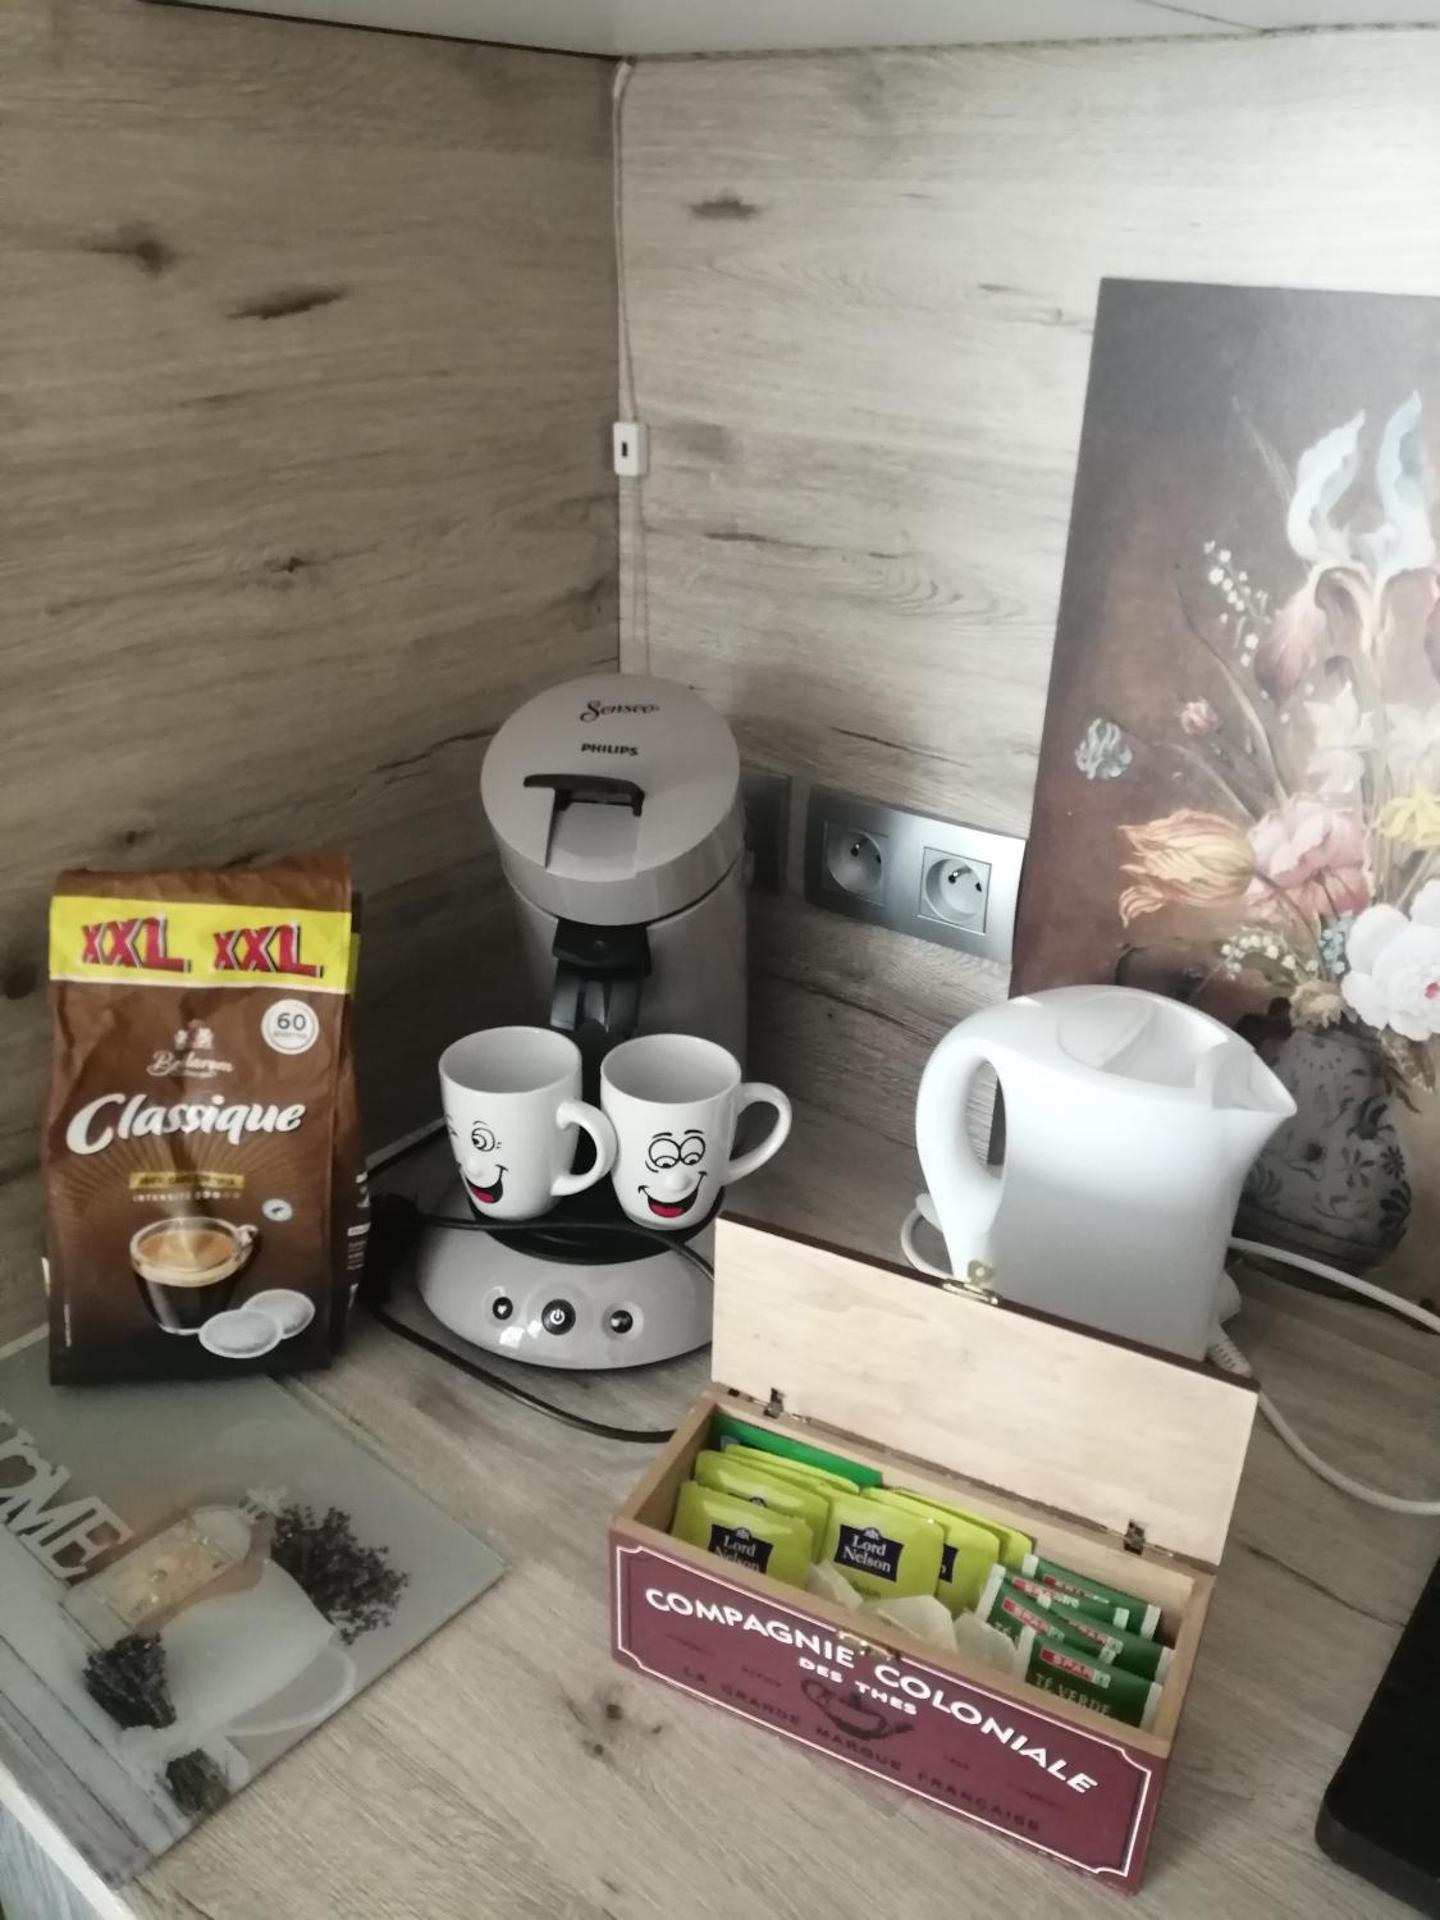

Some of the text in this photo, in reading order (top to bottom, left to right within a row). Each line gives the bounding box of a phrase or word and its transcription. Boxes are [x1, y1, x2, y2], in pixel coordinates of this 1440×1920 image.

[581, 743, 638, 756] PHILIPS
[81, 914, 323, 978] XXL XXL
[276, 1012, 307, 1032] 60
[66, 1093, 306, 1155] Classique
[723, 1534, 757, 1557] Lord
[842, 1545, 892, 1574] Nelson
[851, 1533, 887, 1557] Lord
[1052, 1654, 1092, 1681] SPAR
[645, 1588, 1098, 1794] COMPAGNIE COLONIALE
[798, 1657, 843, 1684] DES
[855, 1680, 917, 1716] THES
[815, 1726, 902, 1771] MARQUE
